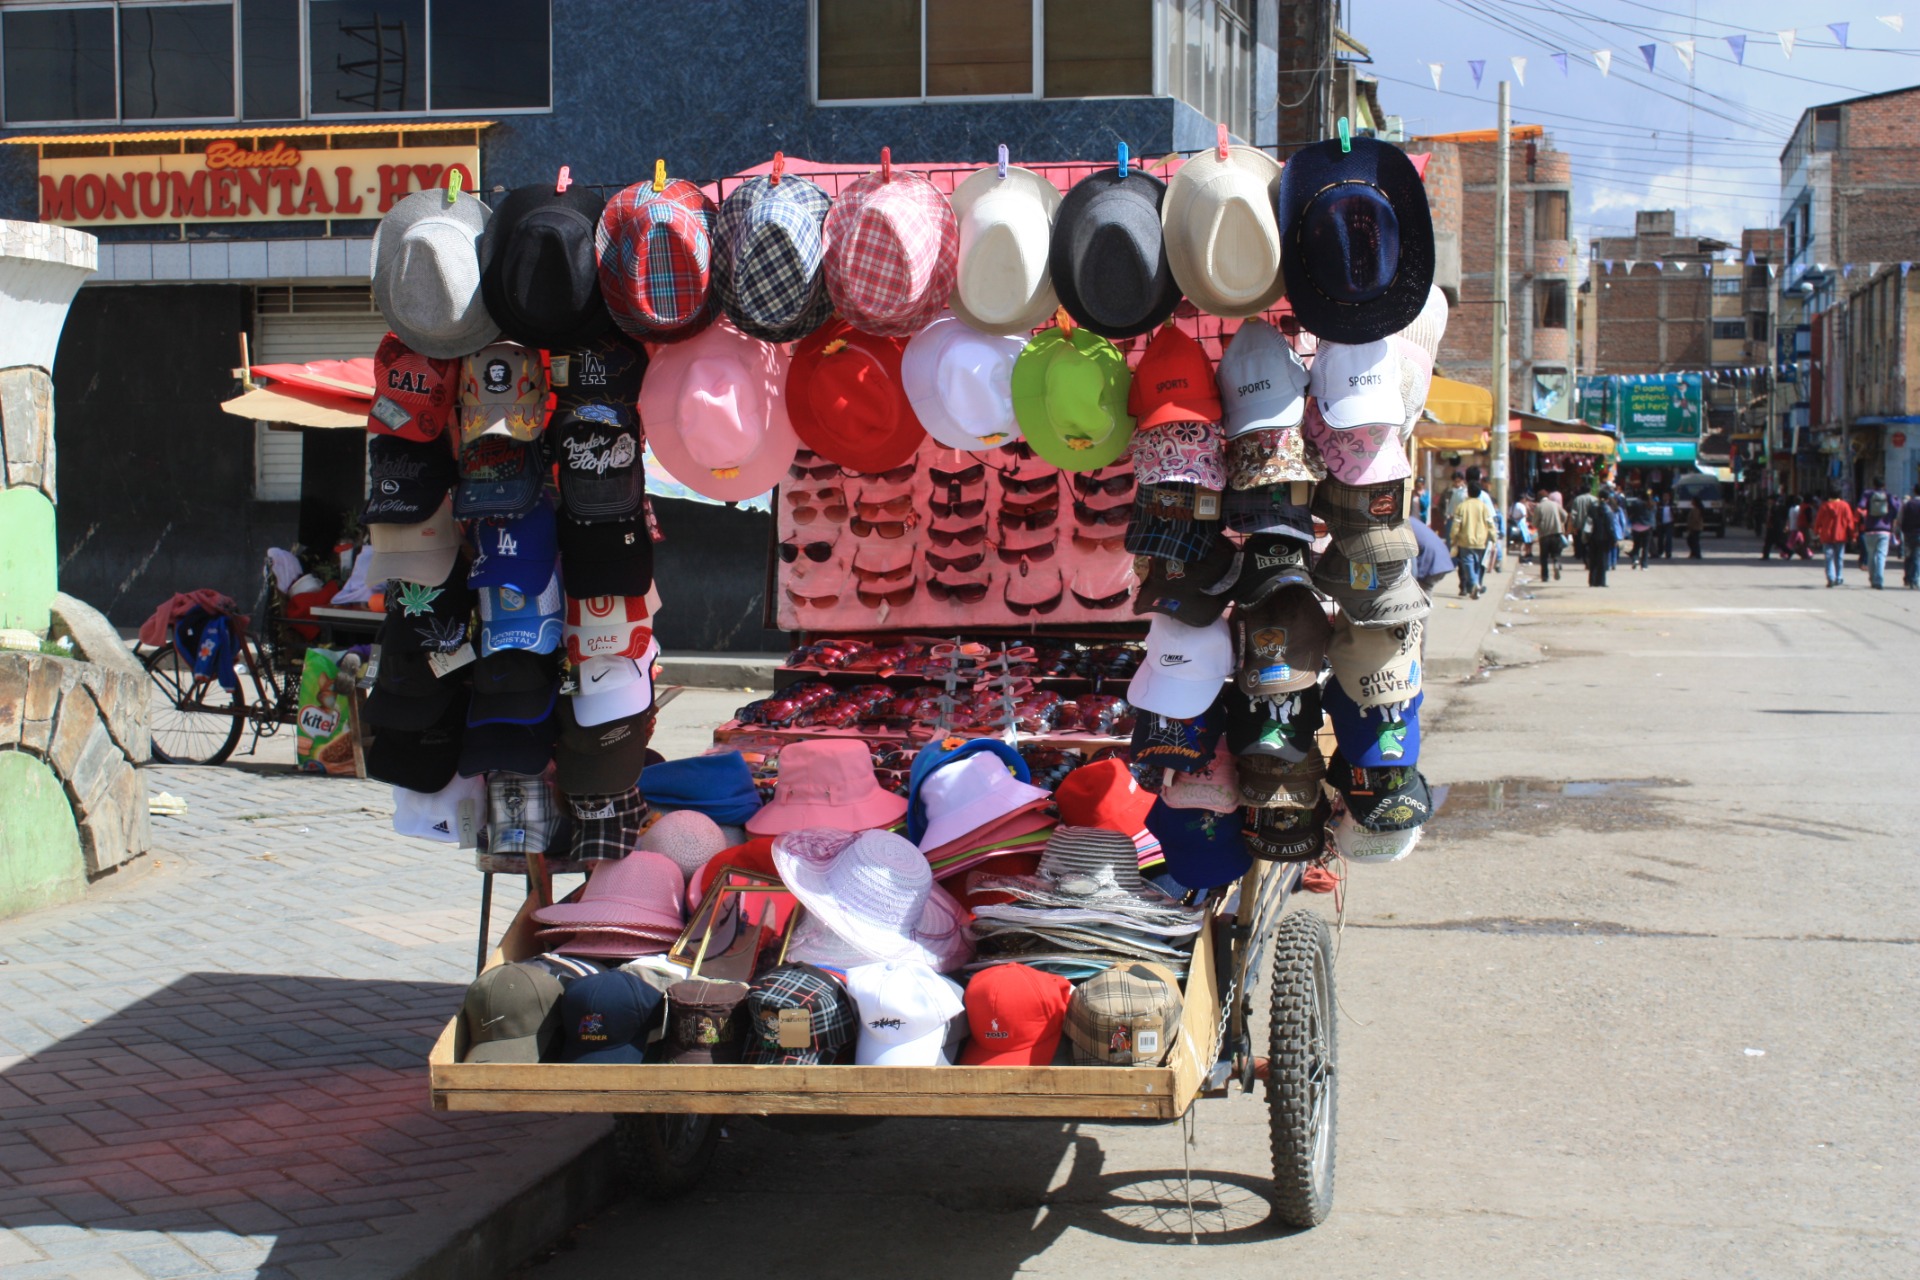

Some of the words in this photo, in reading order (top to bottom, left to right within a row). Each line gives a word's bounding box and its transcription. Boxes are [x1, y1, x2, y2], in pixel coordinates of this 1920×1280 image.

[205, 139, 301, 170] Banda
[579, 350, 607, 385] LA
[388, 369, 432, 395] CAL
[1156, 378, 1188, 393] SPORTS
[1238, 379, 1271, 397] SPORTS
[1349, 374, 1382, 387] SPORTS
[563, 432, 611, 459] Fender
[1543, 440, 1592, 449] COMERCIAL
[497, 528, 517, 556] LA
[1259, 553, 1303, 568] RENCA
[490, 630, 537, 645] SPORTING
[494, 636, 533, 646] CRISTAL
[587, 634, 618, 647] DALE
[1359, 669, 1396, 687] QUIK
[1362, 680, 1413, 697] SILVER
[1137, 745, 1202, 760] SPIDERMAN
[1257, 793, 1266, 801] 10
[1270, 793, 1299, 802] ALIEN
[1398, 794, 1428, 813] FORCE
[1267, 844, 1277, 853] 10
[1281, 841, 1309, 854] ALIEN
[581, 1033, 608, 1041] SPIDER
